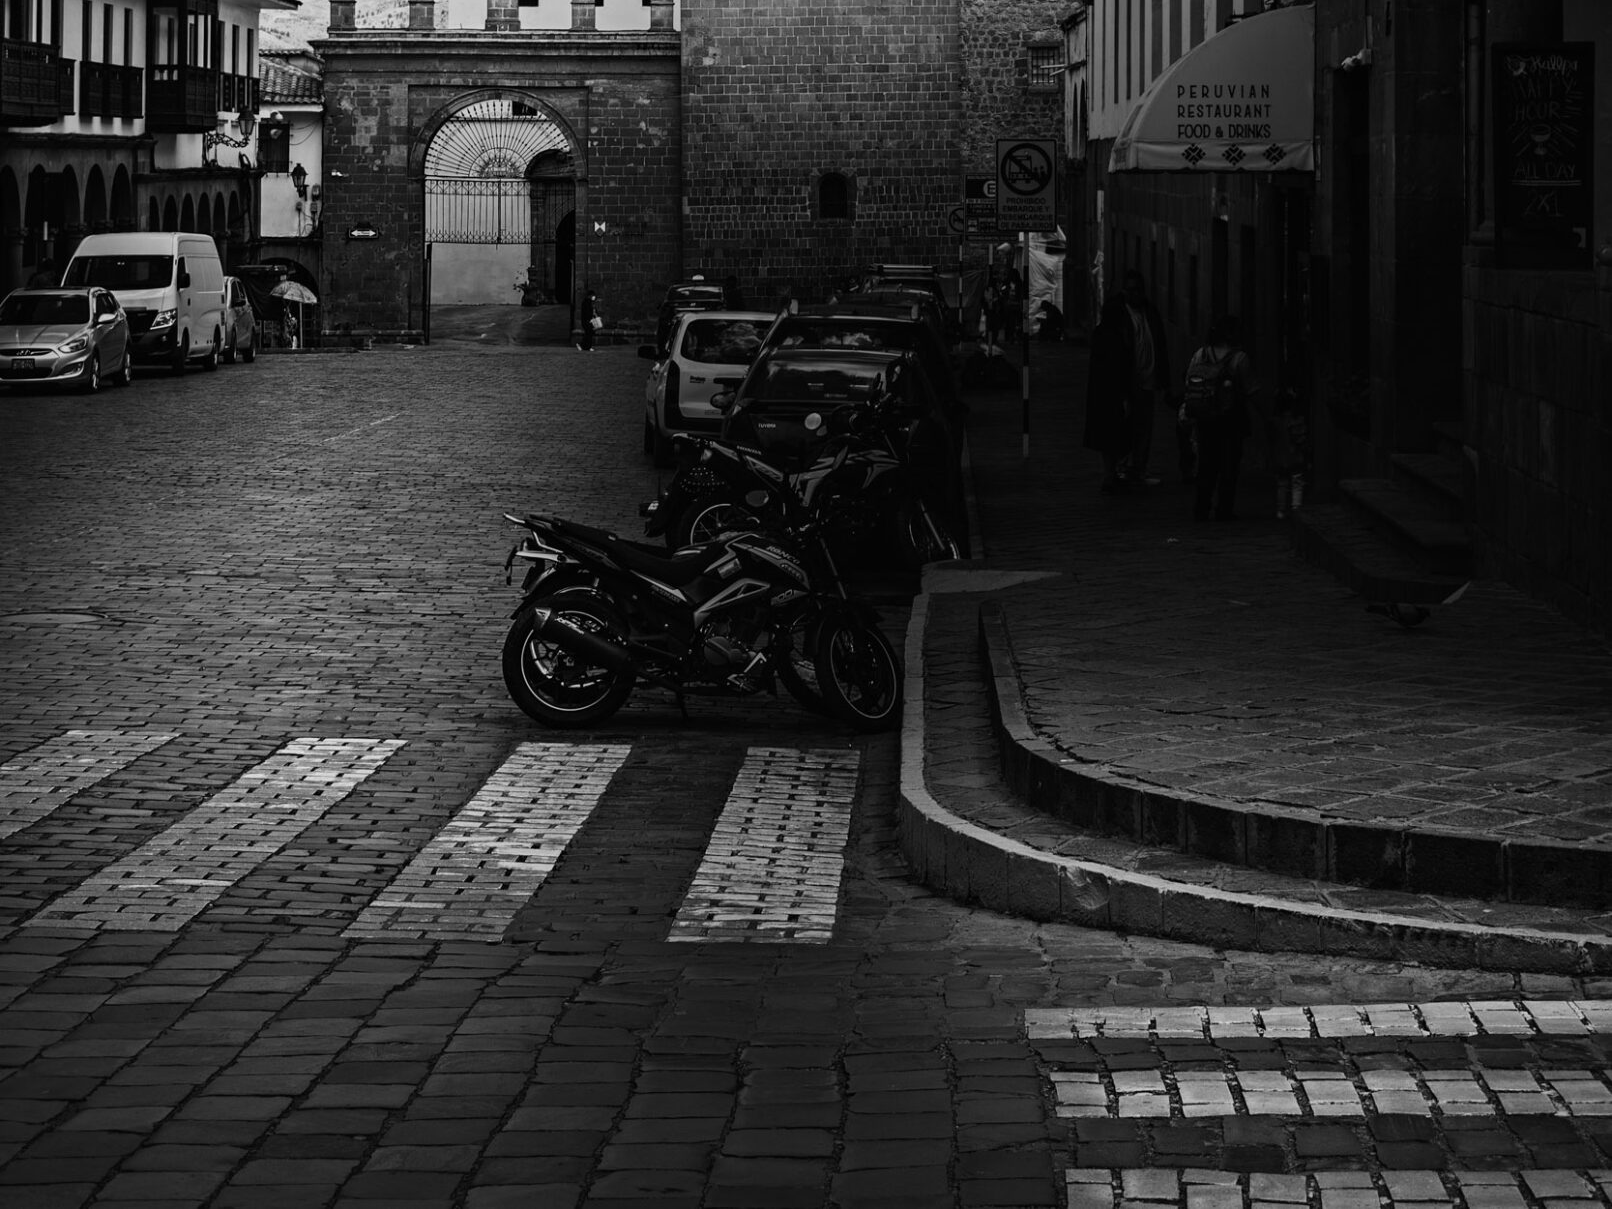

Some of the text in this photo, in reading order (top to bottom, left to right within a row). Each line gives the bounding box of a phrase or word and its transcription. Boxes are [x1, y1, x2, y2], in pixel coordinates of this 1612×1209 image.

[1177, 85, 1269, 98] PERUVIAN
[1177, 104, 1271, 118] RESTAURANT
[1514, 100, 1561, 119] HOUR
[1178, 124, 1271, 139] FOOD & DRINKS
[1514, 161, 1576, 179] ALL DAY
[1006, 197, 1046, 205] PROHIBIDO
[1003, 205, 1042, 213] EMBARQUE
